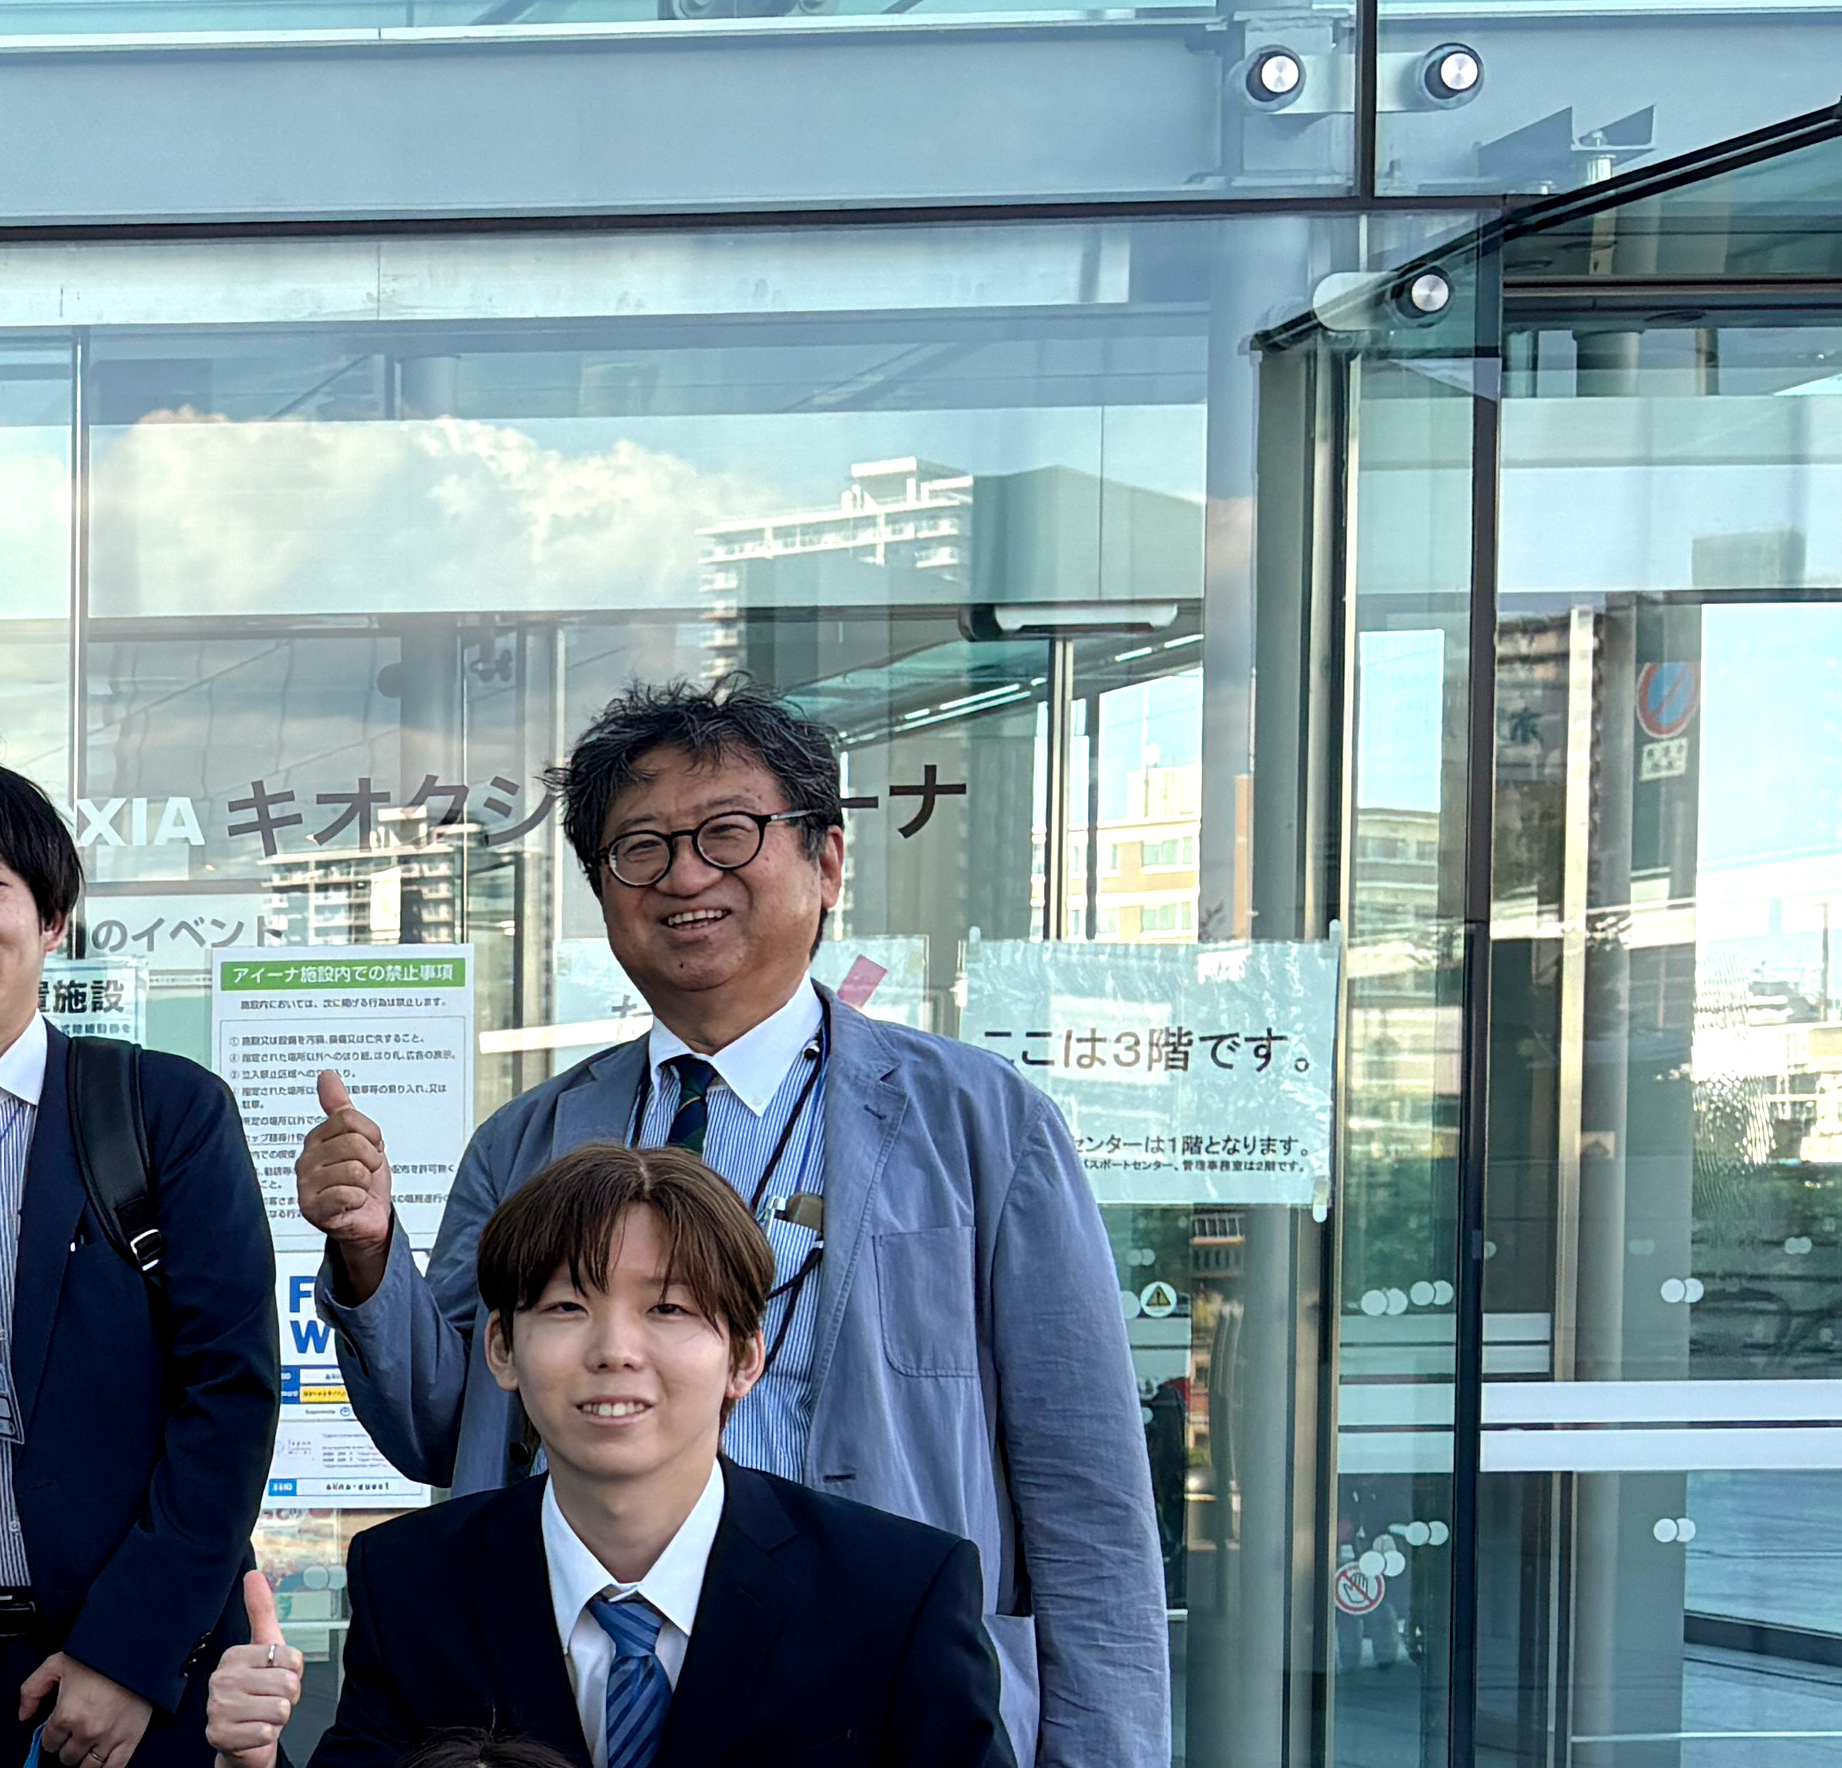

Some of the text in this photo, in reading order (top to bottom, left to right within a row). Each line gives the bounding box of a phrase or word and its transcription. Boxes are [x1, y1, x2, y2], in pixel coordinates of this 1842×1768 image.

[228, 774, 556, 857] キオクシ
[232, 964, 454, 983] アイーナ施設内での禁止事項
